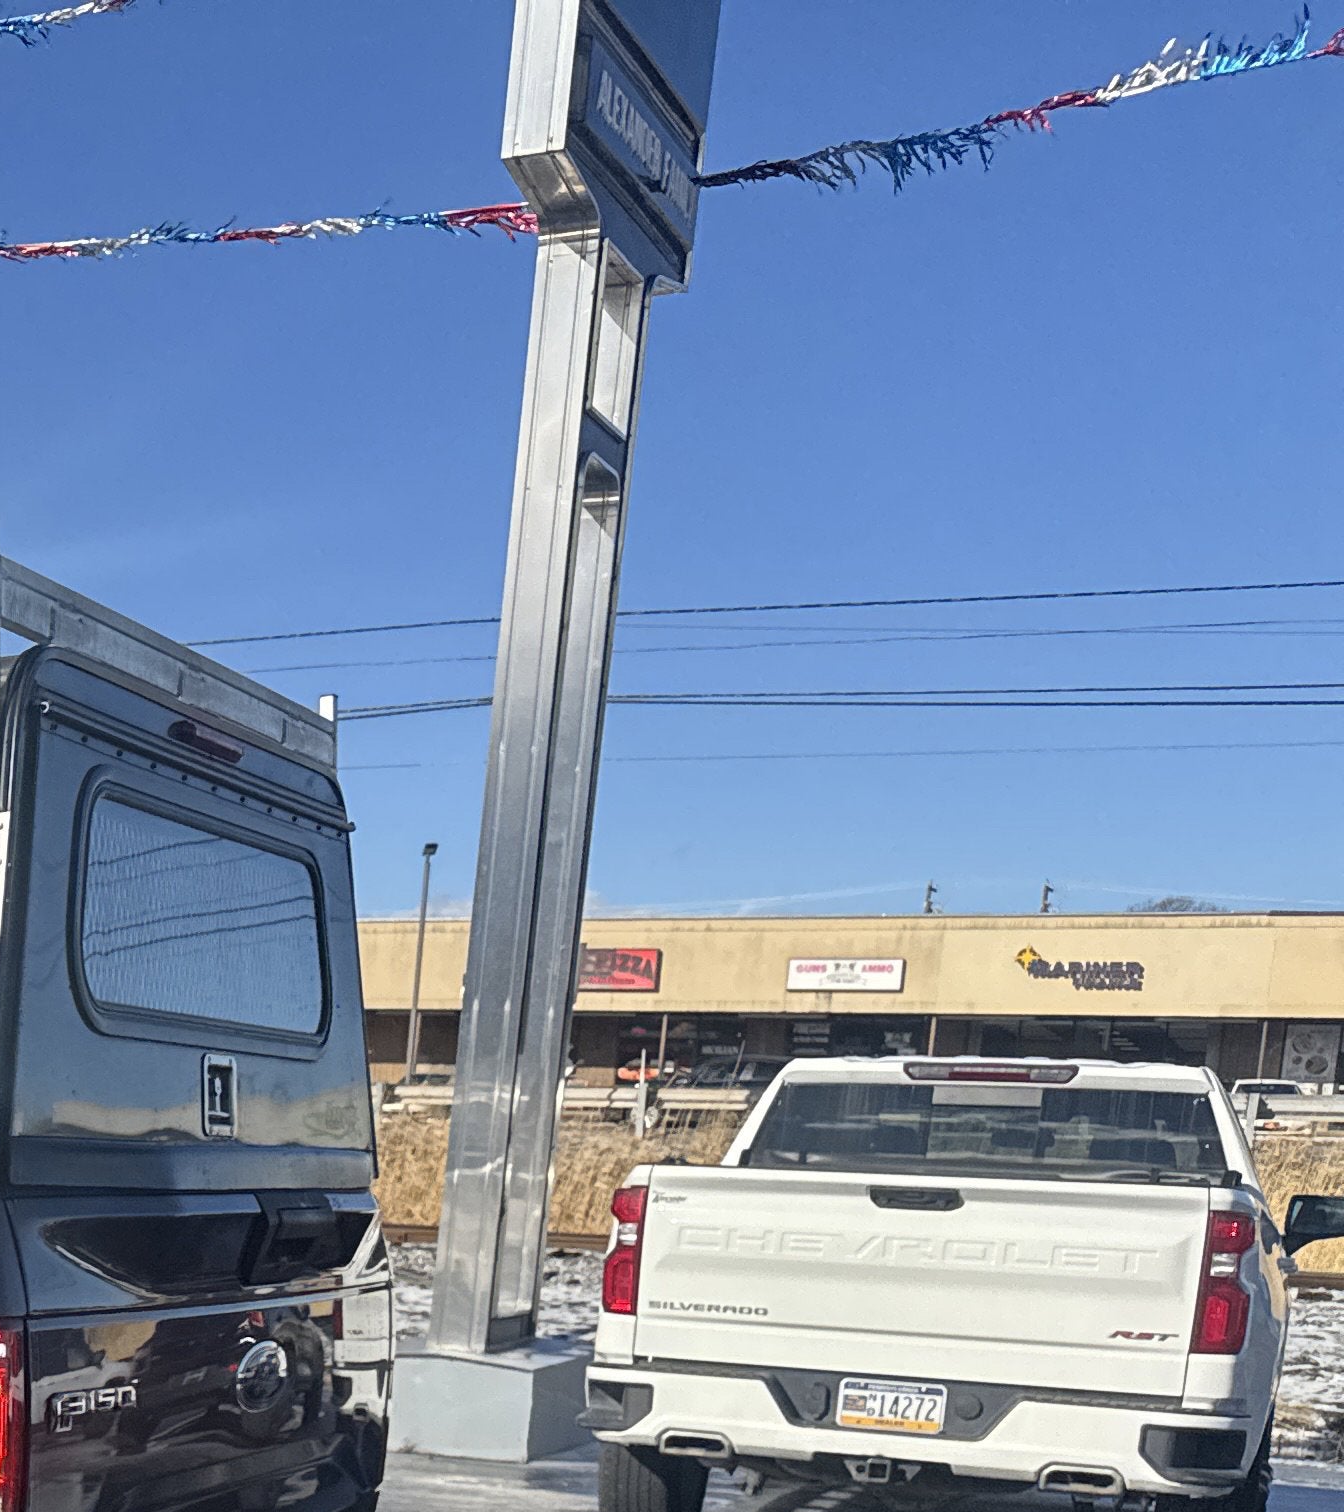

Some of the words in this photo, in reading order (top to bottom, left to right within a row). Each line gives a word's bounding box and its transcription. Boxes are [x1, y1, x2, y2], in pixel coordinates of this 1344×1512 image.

[796, 964, 828, 973] GUNS
[860, 964, 895, 973] AMMO
[1028, 960, 1144, 979] MARINER
[676, 1226, 1160, 1275] CHEVROLET
[648, 1300, 769, 1317] SILVERADO
[1108, 1329, 1180, 1343] RST
[877, 1394, 938, 1423] 14272
